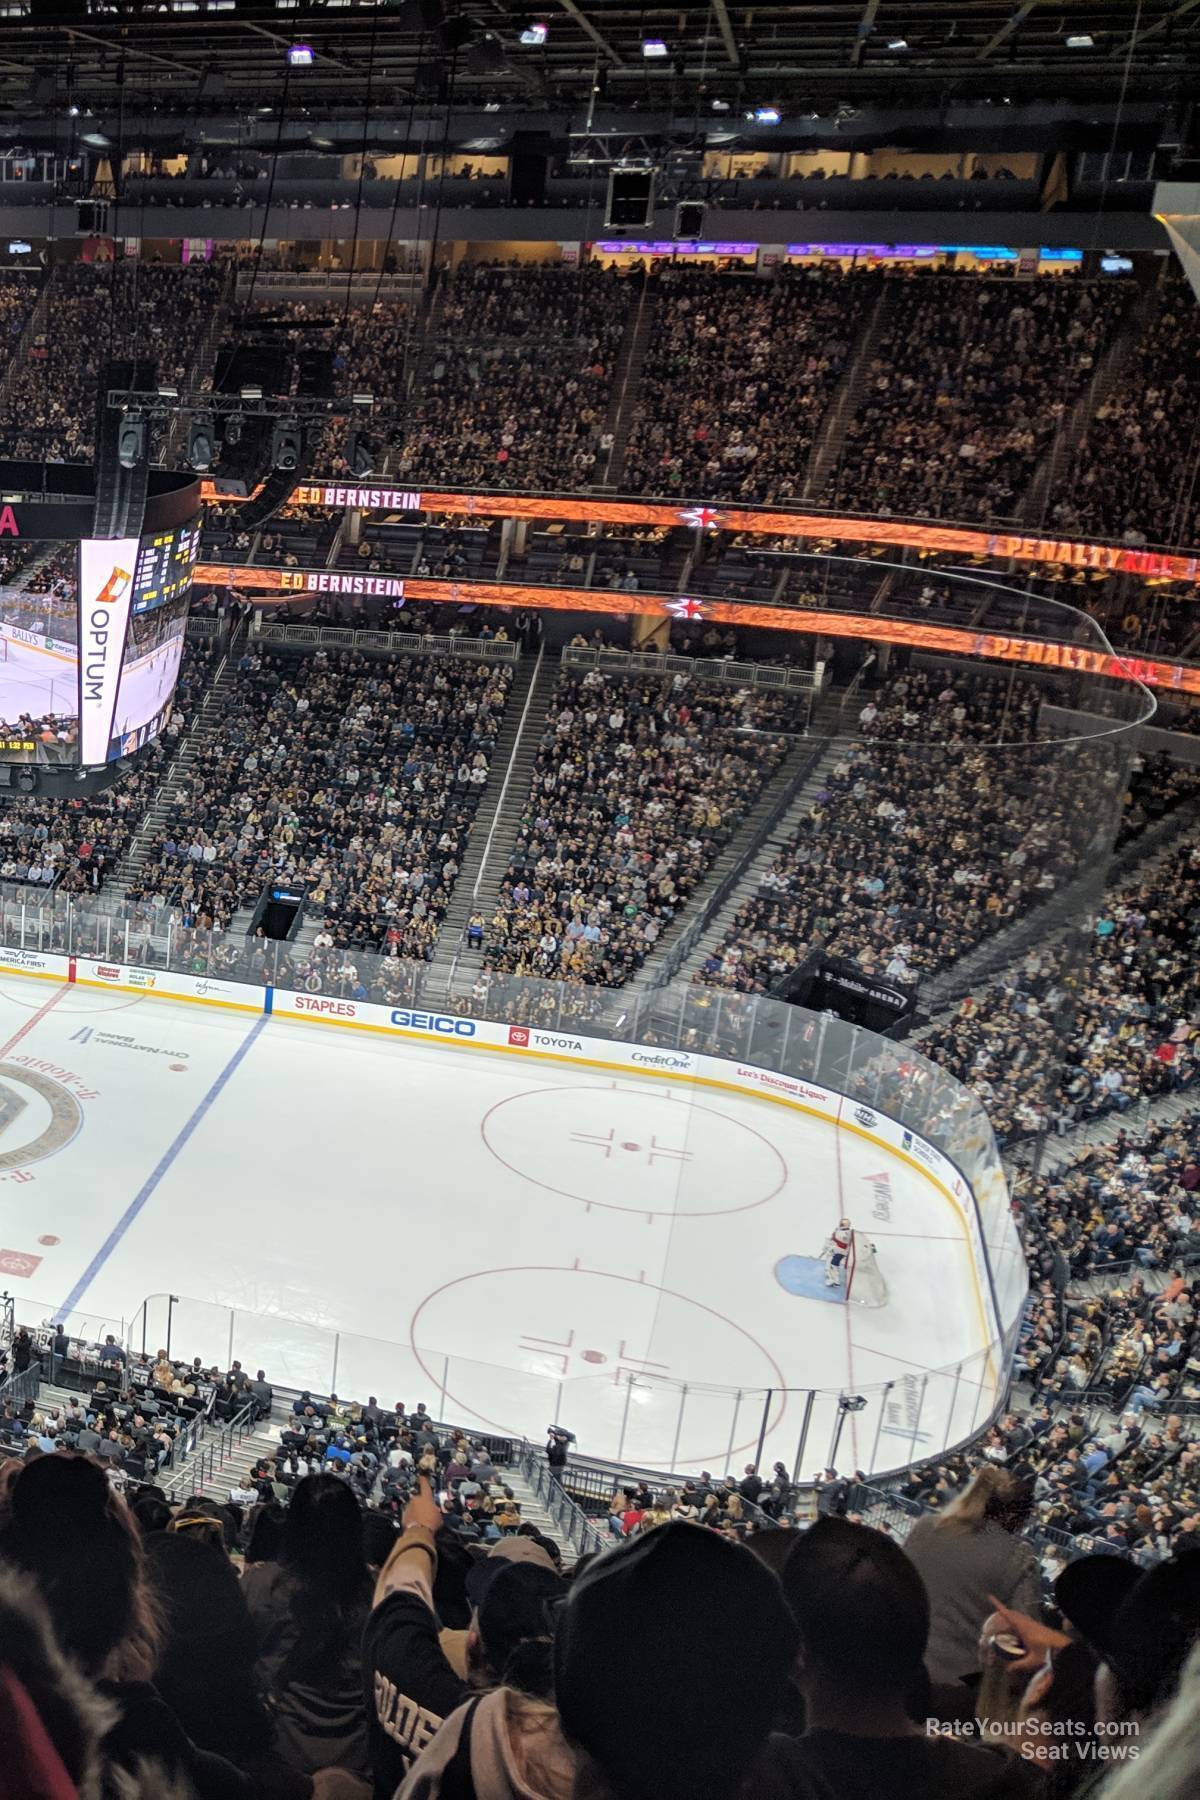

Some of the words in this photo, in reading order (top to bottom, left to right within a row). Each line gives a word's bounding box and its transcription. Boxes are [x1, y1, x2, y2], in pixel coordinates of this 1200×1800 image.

[299, 487, 320, 504] ED
[325, 488, 421, 510] BERNSTEIN
[1006, 536, 1121, 568] PENALTY
[1123, 551, 1173, 577] KILL
[281, 572, 303, 589] ED
[308, 574, 404, 596] BERNSTEIN
[84, 609, 110, 701] OPTUM
[993, 636, 1107, 673] PENALTY
[1108, 656, 1159, 685] KILL
[22, 958, 46, 969] FIRST
[295, 996, 356, 1018] STAPLES
[869, 989, 900, 1006] ARENA
[390, 1009, 476, 1037] GEICO
[93, 1037, 161, 1054] NATIONAL
[533, 1034, 583, 1052] TOYOTA
[760, 1073, 798, 1093] Discount
[800, 1084, 829, 1102] Liquor
